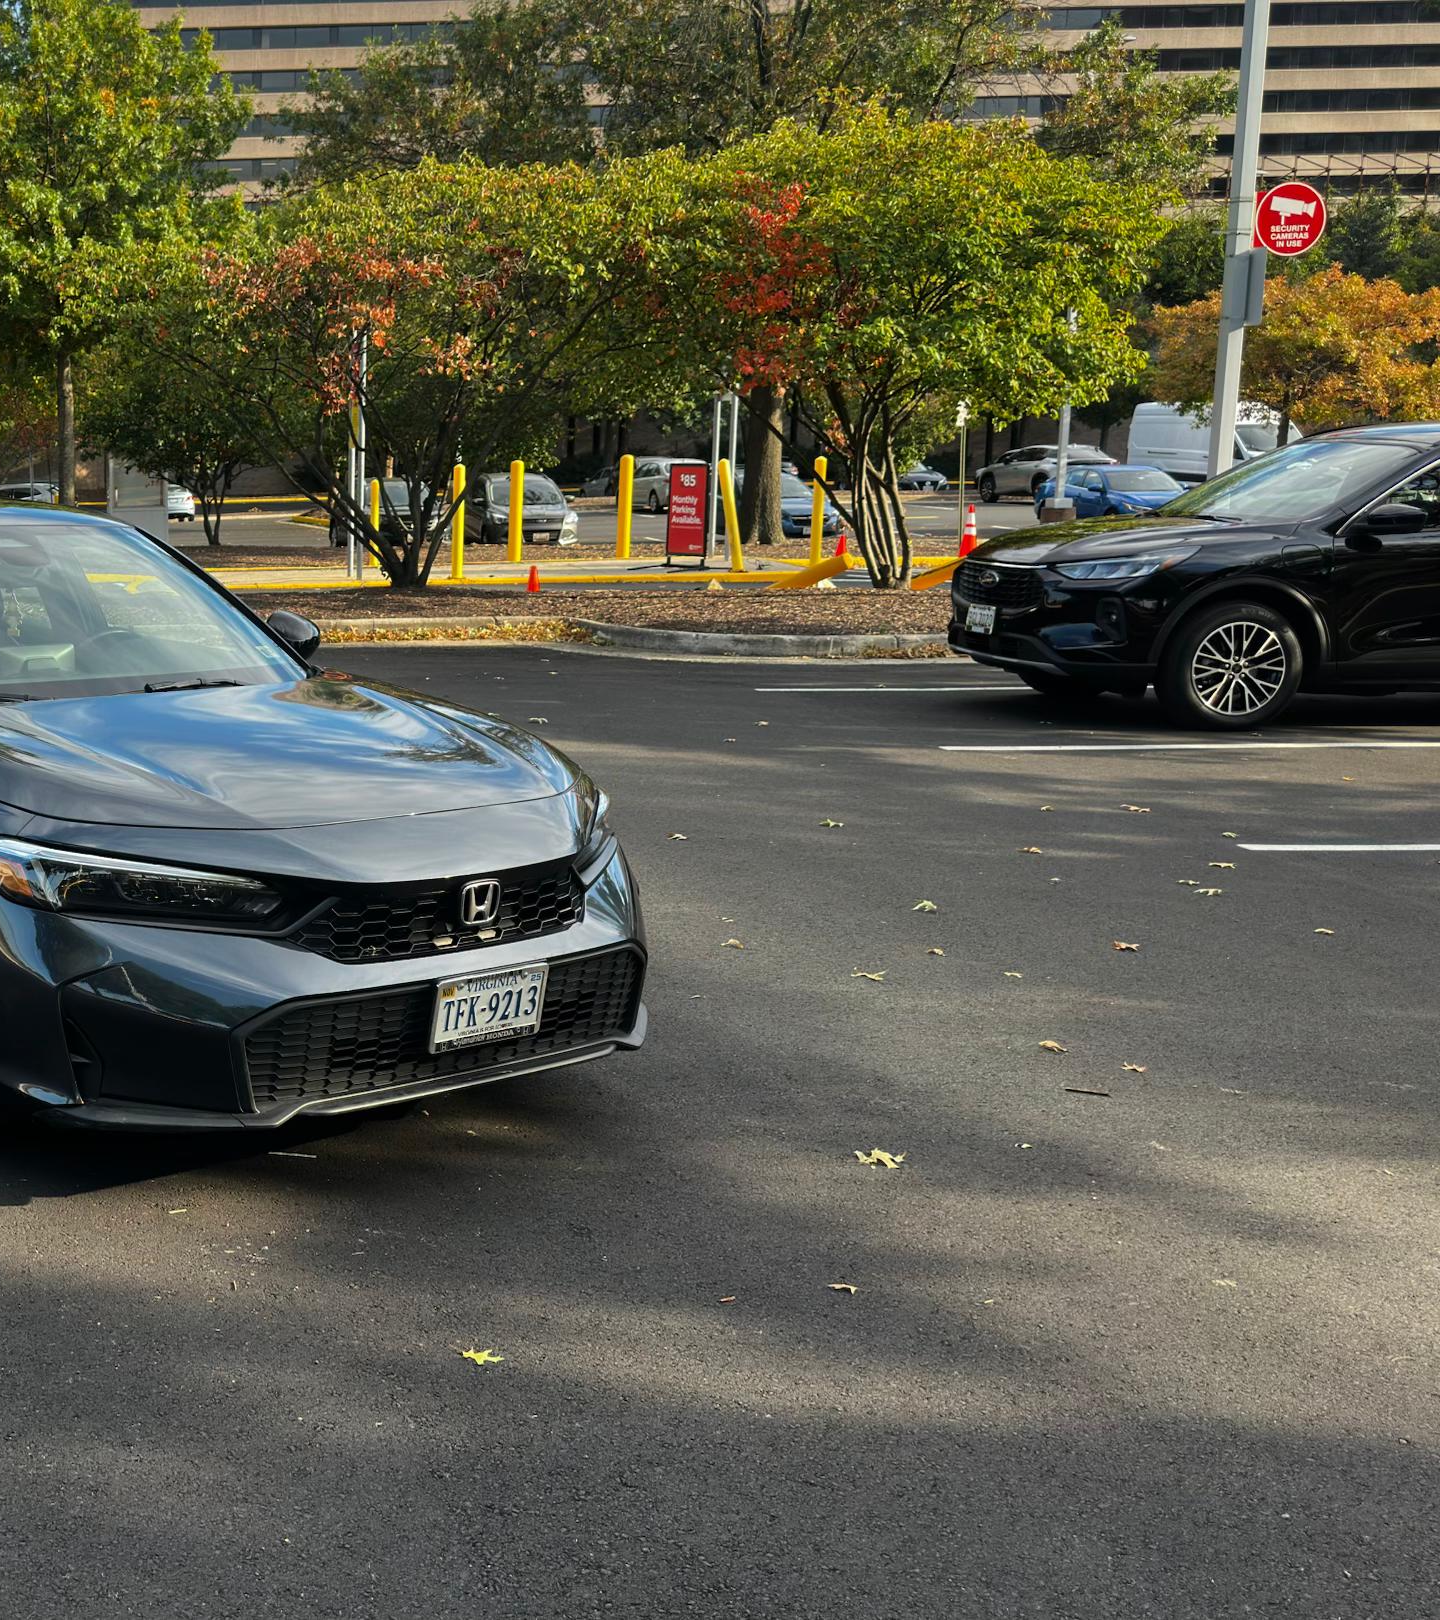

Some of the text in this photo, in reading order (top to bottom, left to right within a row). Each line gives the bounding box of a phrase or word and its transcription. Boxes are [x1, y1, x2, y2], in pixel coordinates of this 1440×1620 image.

[1270, 224, 1310, 232] SECURITY
[1270, 232, 1309, 240] CAMERAS
[680, 473, 696, 487] $85
[671, 495, 698, 506] Monthly
[671, 505, 696, 516] Parking
[671, 515, 703, 525] Available.
[530, 974, 541, 982] 25
[466, 975, 518, 993] VIRGINIA
[442, 986, 455, 997] NOV
[442, 985, 538, 1033] TFK-9213
[486, 1029, 514, 1040] HONDA
